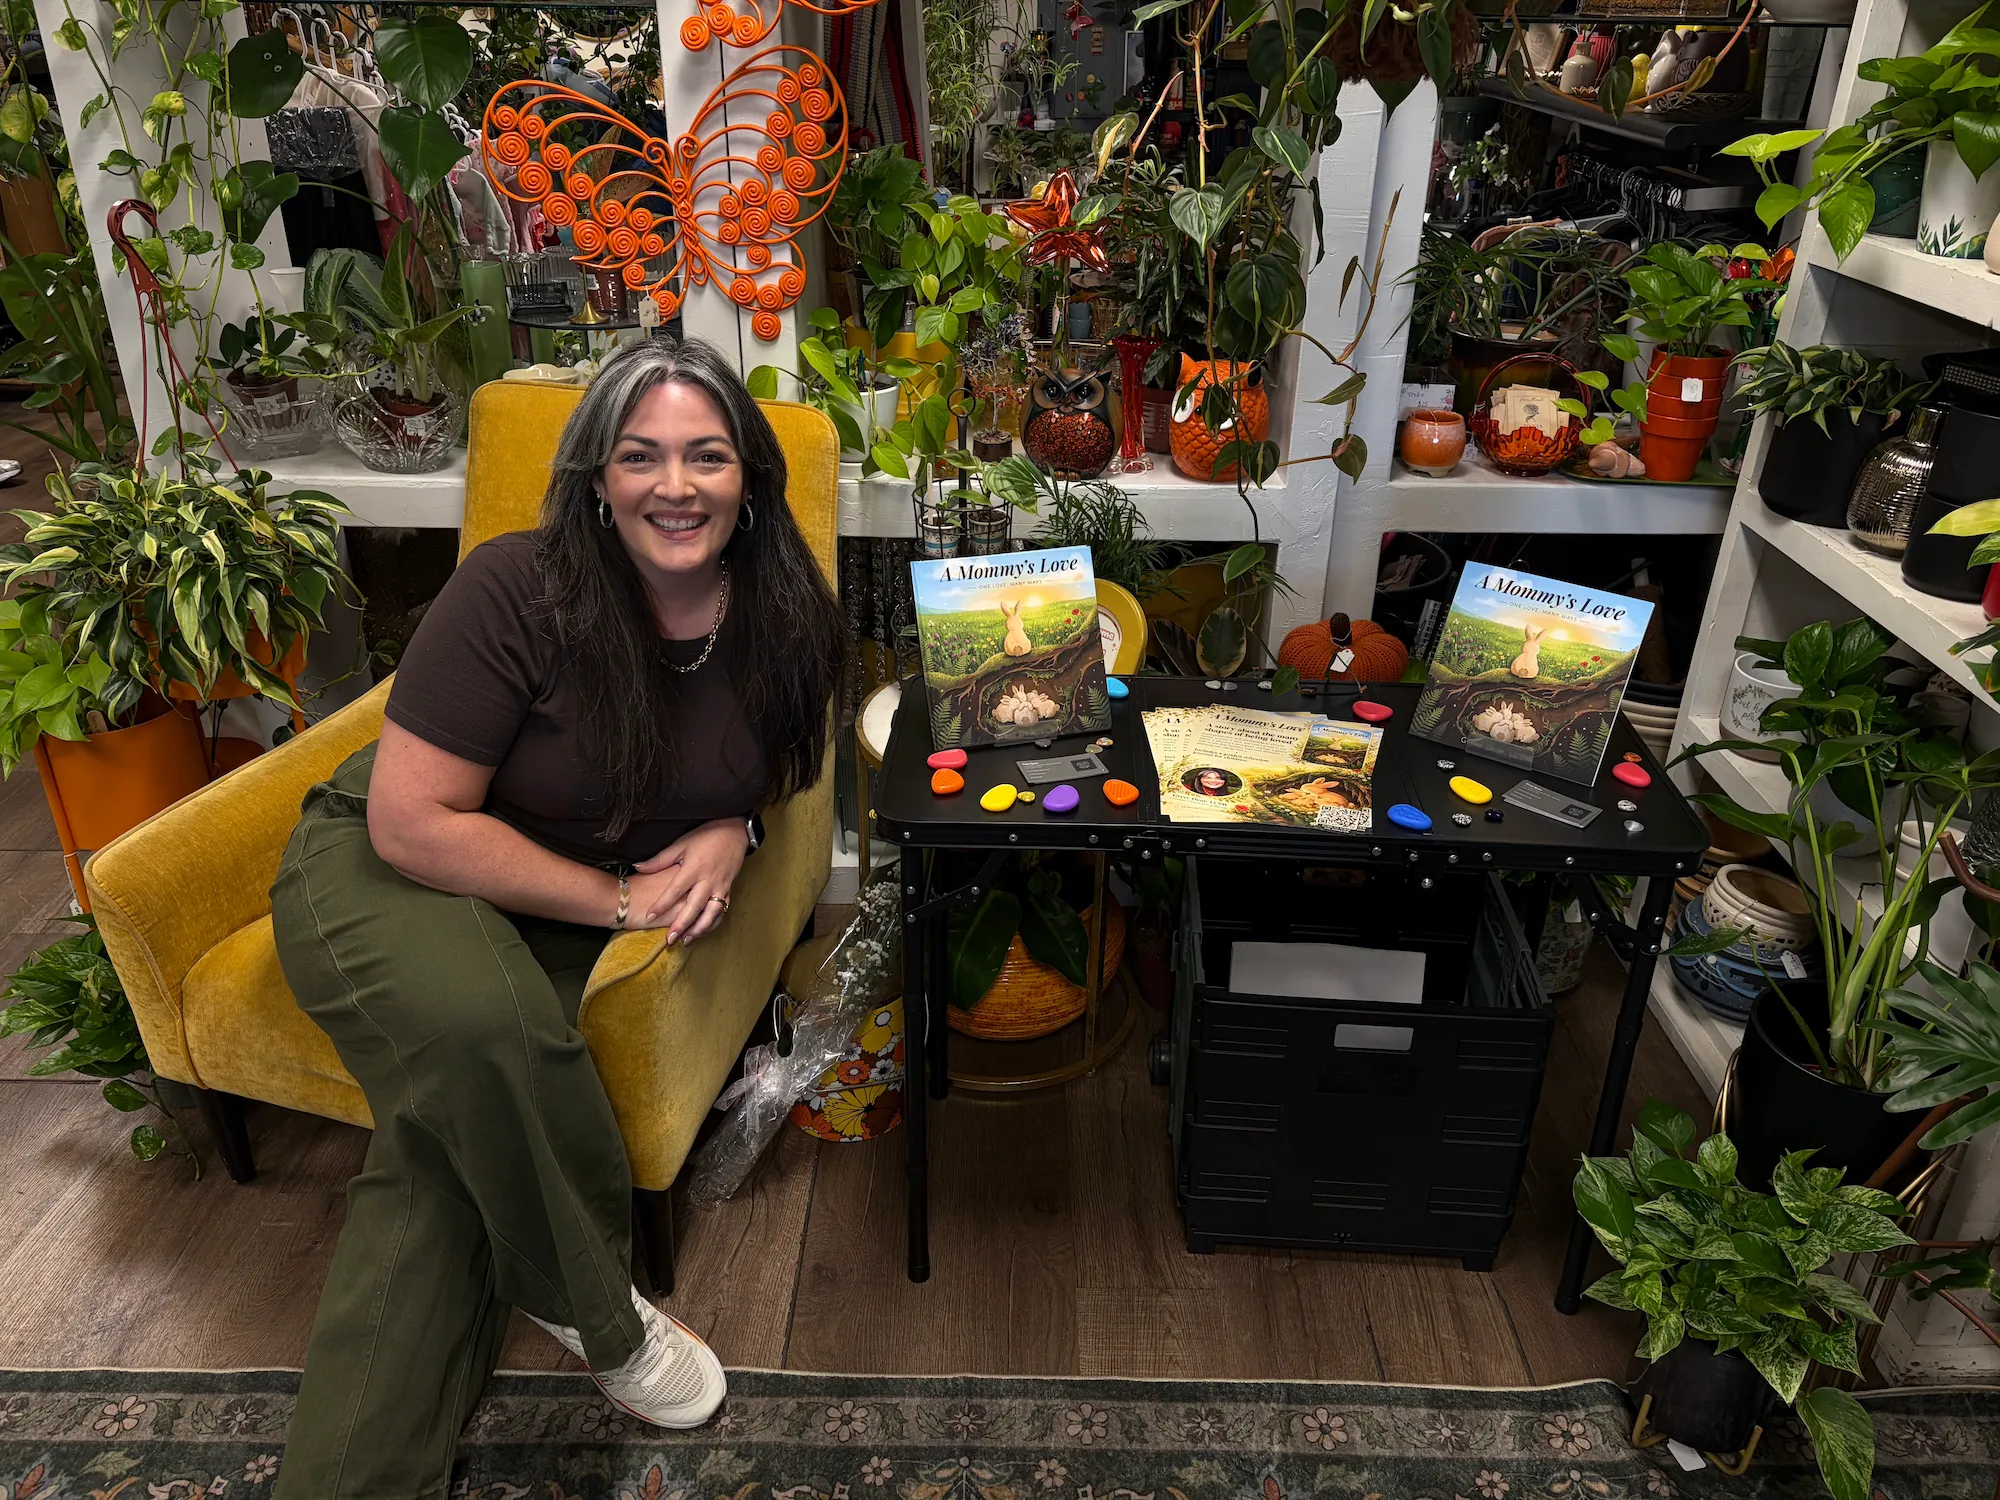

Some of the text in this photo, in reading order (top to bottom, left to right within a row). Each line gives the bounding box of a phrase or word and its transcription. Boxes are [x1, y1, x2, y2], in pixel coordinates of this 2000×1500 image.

[940, 558, 1078, 583] A Mommy's Love
[1474, 574, 1626, 621] A Mommy's Love
[1509, 601, 1522, 609] ONE
[1542, 609, 1560, 617] MANY
[1561, 613, 1578, 622] WAYS
[1204, 727, 1233, 735] shapes
[1245, 733, 1268, 742] being
[1222, 715, 1277, 728] Mommy's
[1278, 723, 1306, 733] Love
